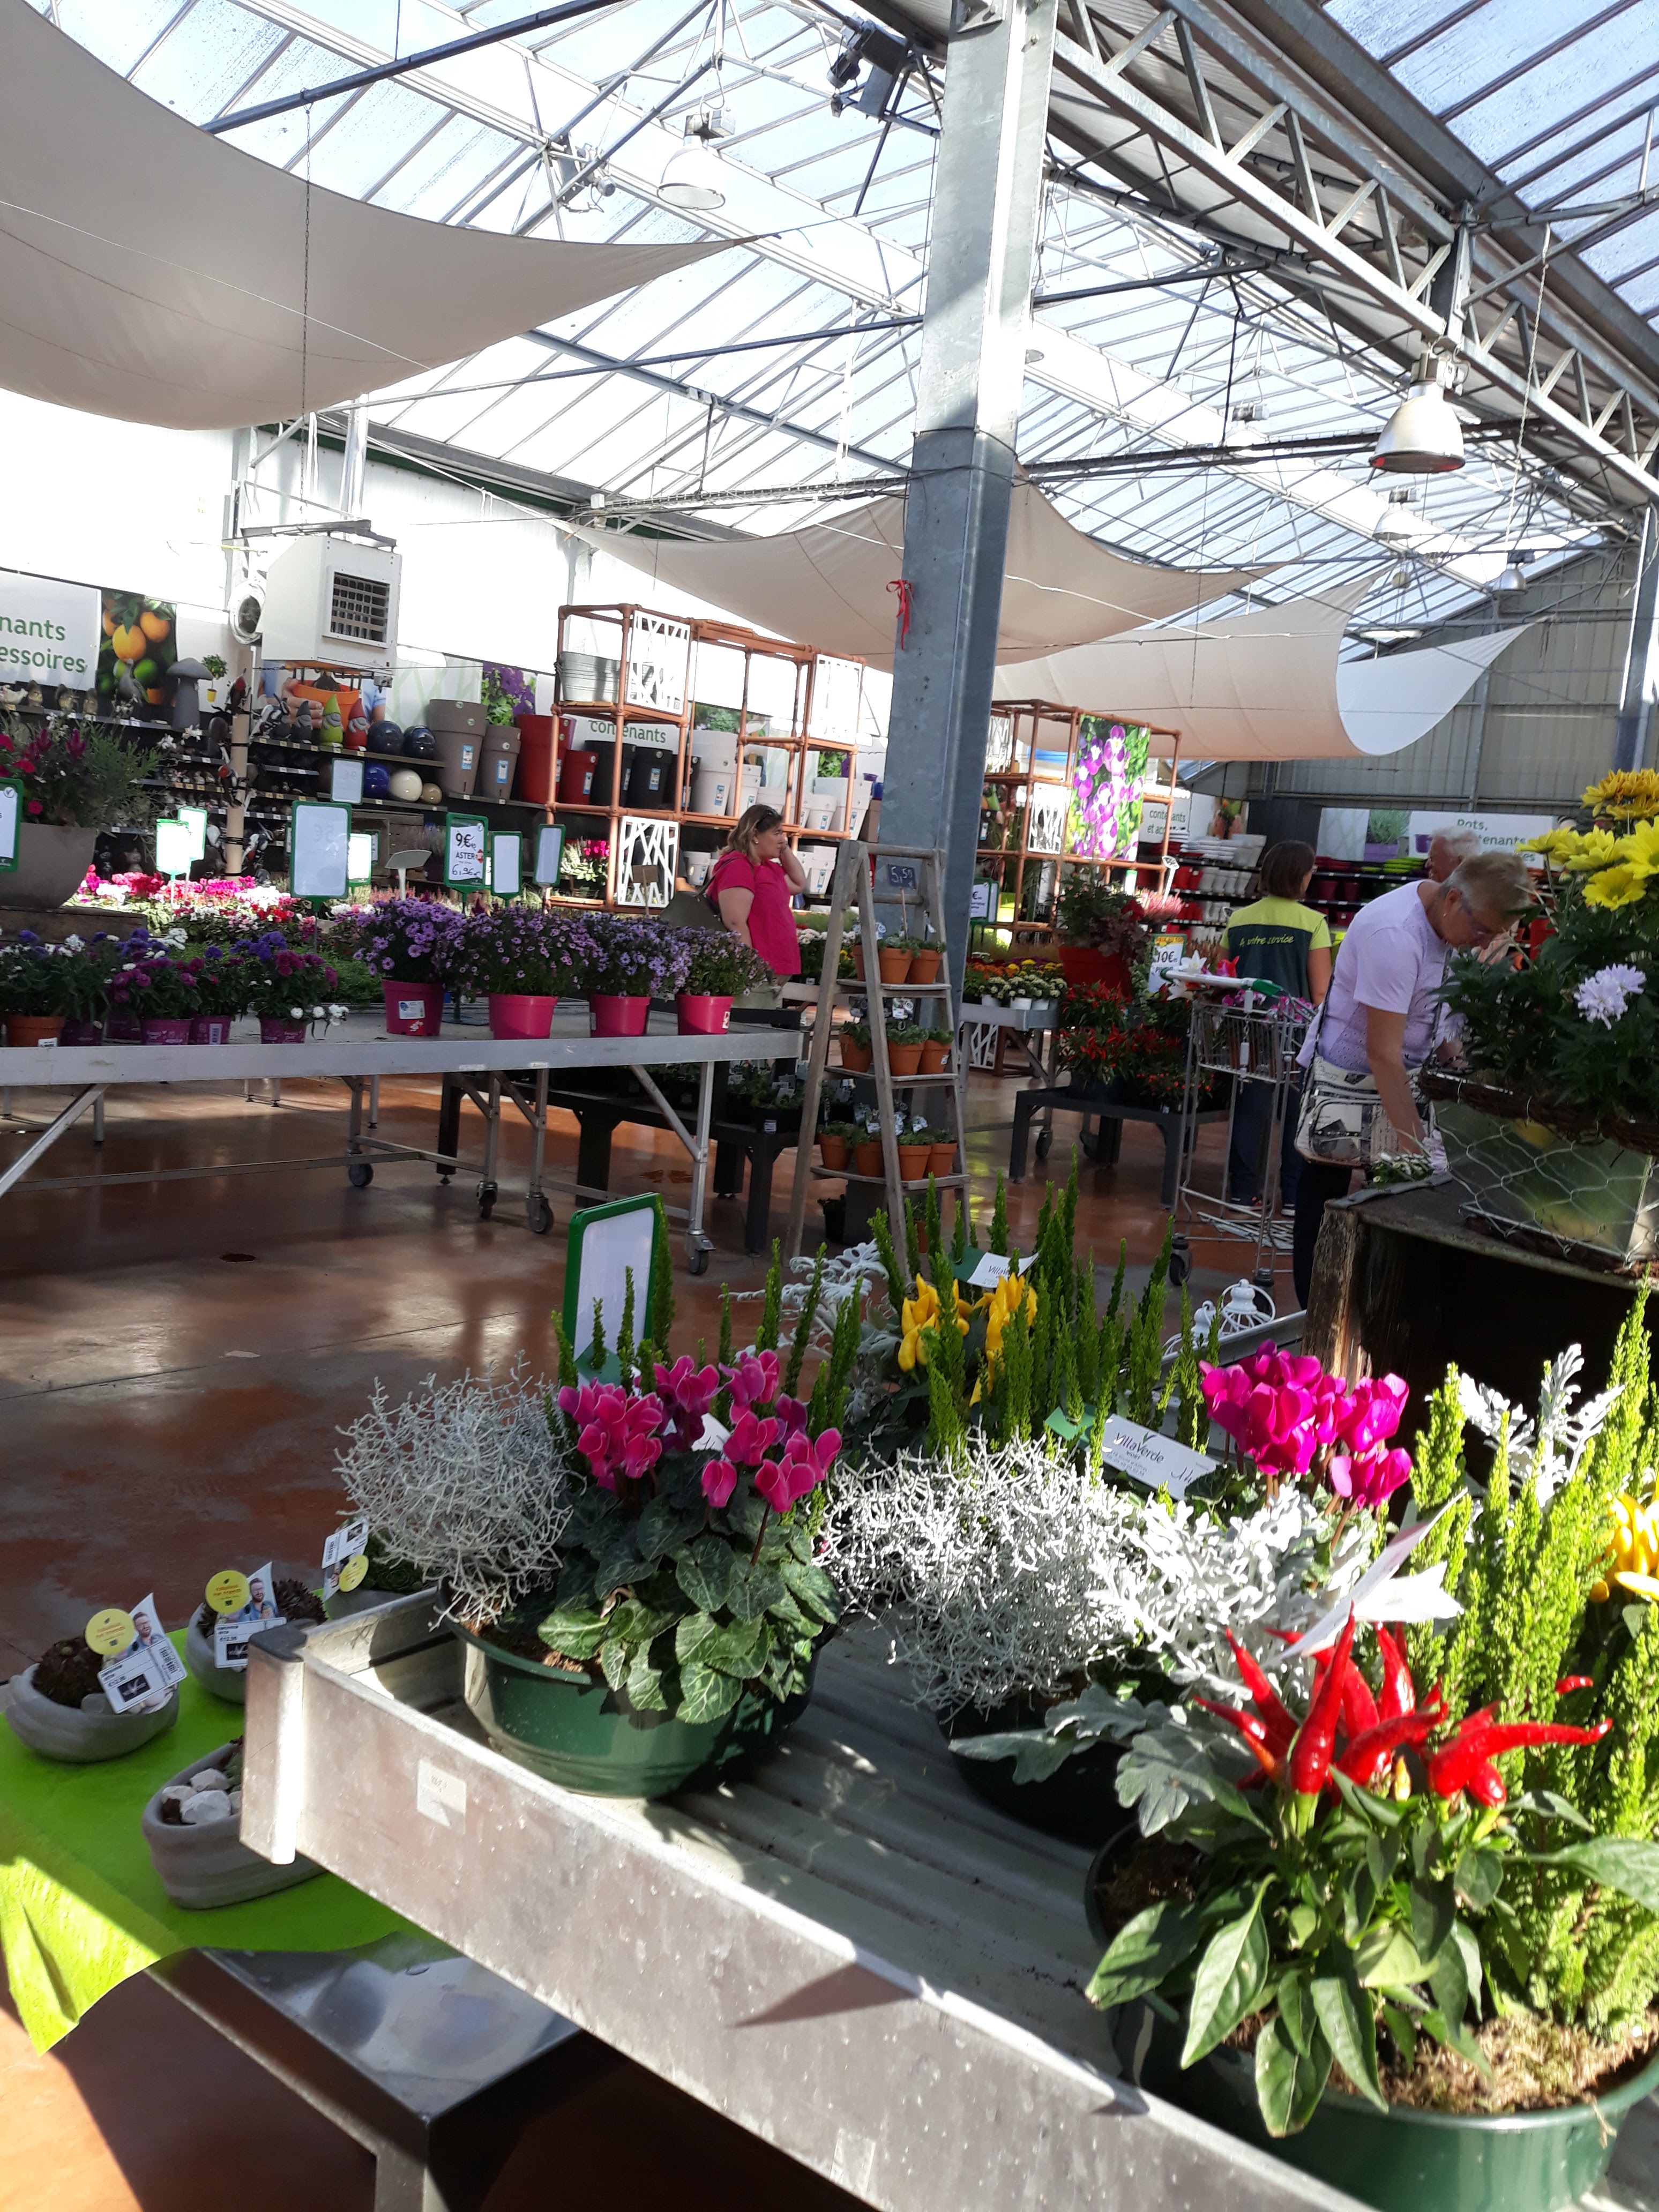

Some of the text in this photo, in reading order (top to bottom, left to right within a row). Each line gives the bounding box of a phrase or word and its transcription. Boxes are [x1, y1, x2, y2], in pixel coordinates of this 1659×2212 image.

[0, 616, 66, 641] nants
[0, 646, 86, 673] essoires
[591, 721, 666, 743] conenants
[1149, 810, 1186, 823] conteants
[455, 852, 475, 860] ASTER
[1246, 935, 1267, 946] votre
[1267, 933, 1294, 945] service
[1116, 1432, 1164, 1464] VillaVerde
